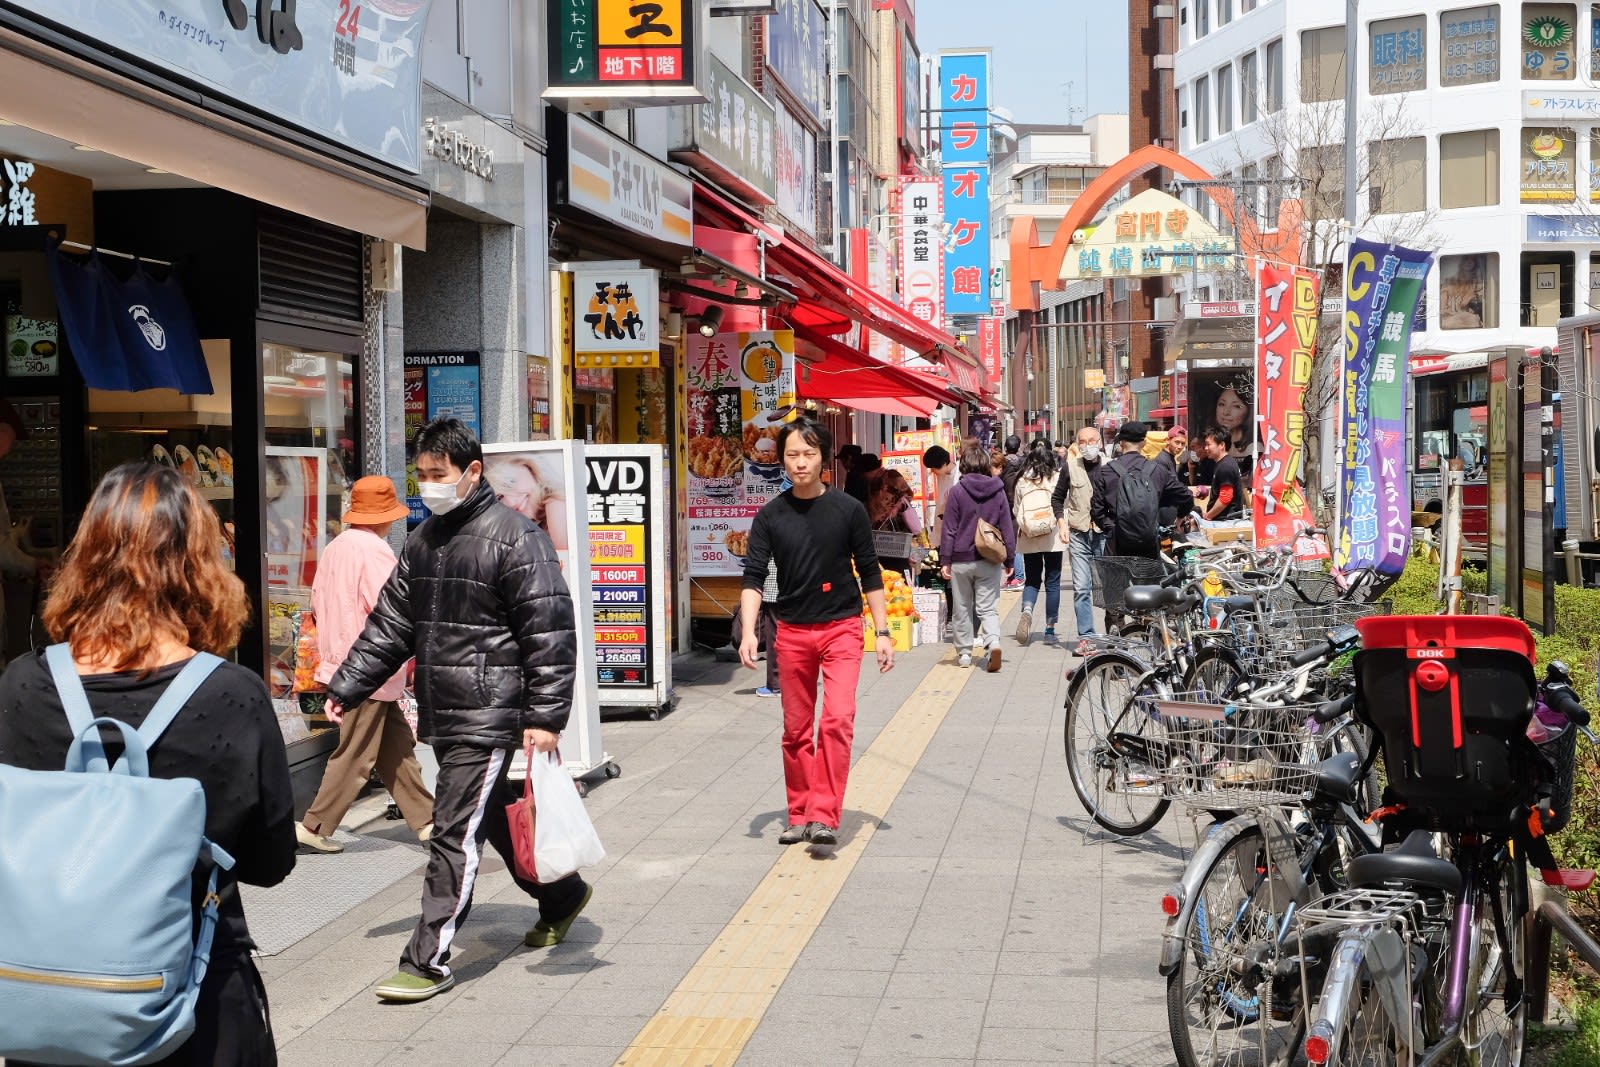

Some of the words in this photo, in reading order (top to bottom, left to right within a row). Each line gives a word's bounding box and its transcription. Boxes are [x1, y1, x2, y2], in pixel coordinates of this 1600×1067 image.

[335, 0, 360, 42] 24
[333, 35, 356, 77] 時間
[1373, 28, 1424, 68] 眼科
[1525, 50, 1570, 71] ゆう
[605, 56, 675, 75] 地下1階
[1375, 68, 1425, 85] クリニック
[1525, 160, 1570, 177] アトラス
[949, 73, 981, 295] カラオケ館
[913, 196, 929, 262] 中華食堂
[1115, 208, 1189, 237] 高円寺
[1078, 240, 1228, 272] 純情商店街
[595, 281, 633, 305] 天丼
[910, 283, 932, 321] 一番
[583, 311, 644, 341] てんや
[404, 355, 465, 365] ORMATION
[1371, 311, 1405, 384] 競馬
[697, 341, 730, 381] 春
[688, 367, 738, 391] らんまん
[762, 352, 778, 412] 柚子味噌
[752, 384, 764, 412] たれ
[1259, 280, 1289, 515] インターネット
[695, 508, 759, 518] 桜海老天丼サー
[599, 544, 633, 558] 1050円
[702, 551, 723, 561] 980
[602, 570, 637, 581] 1600円
[603, 591, 638, 602] 2100円
[603, 632, 639, 642] 3150円
[605, 653, 641, 663] 2650円
